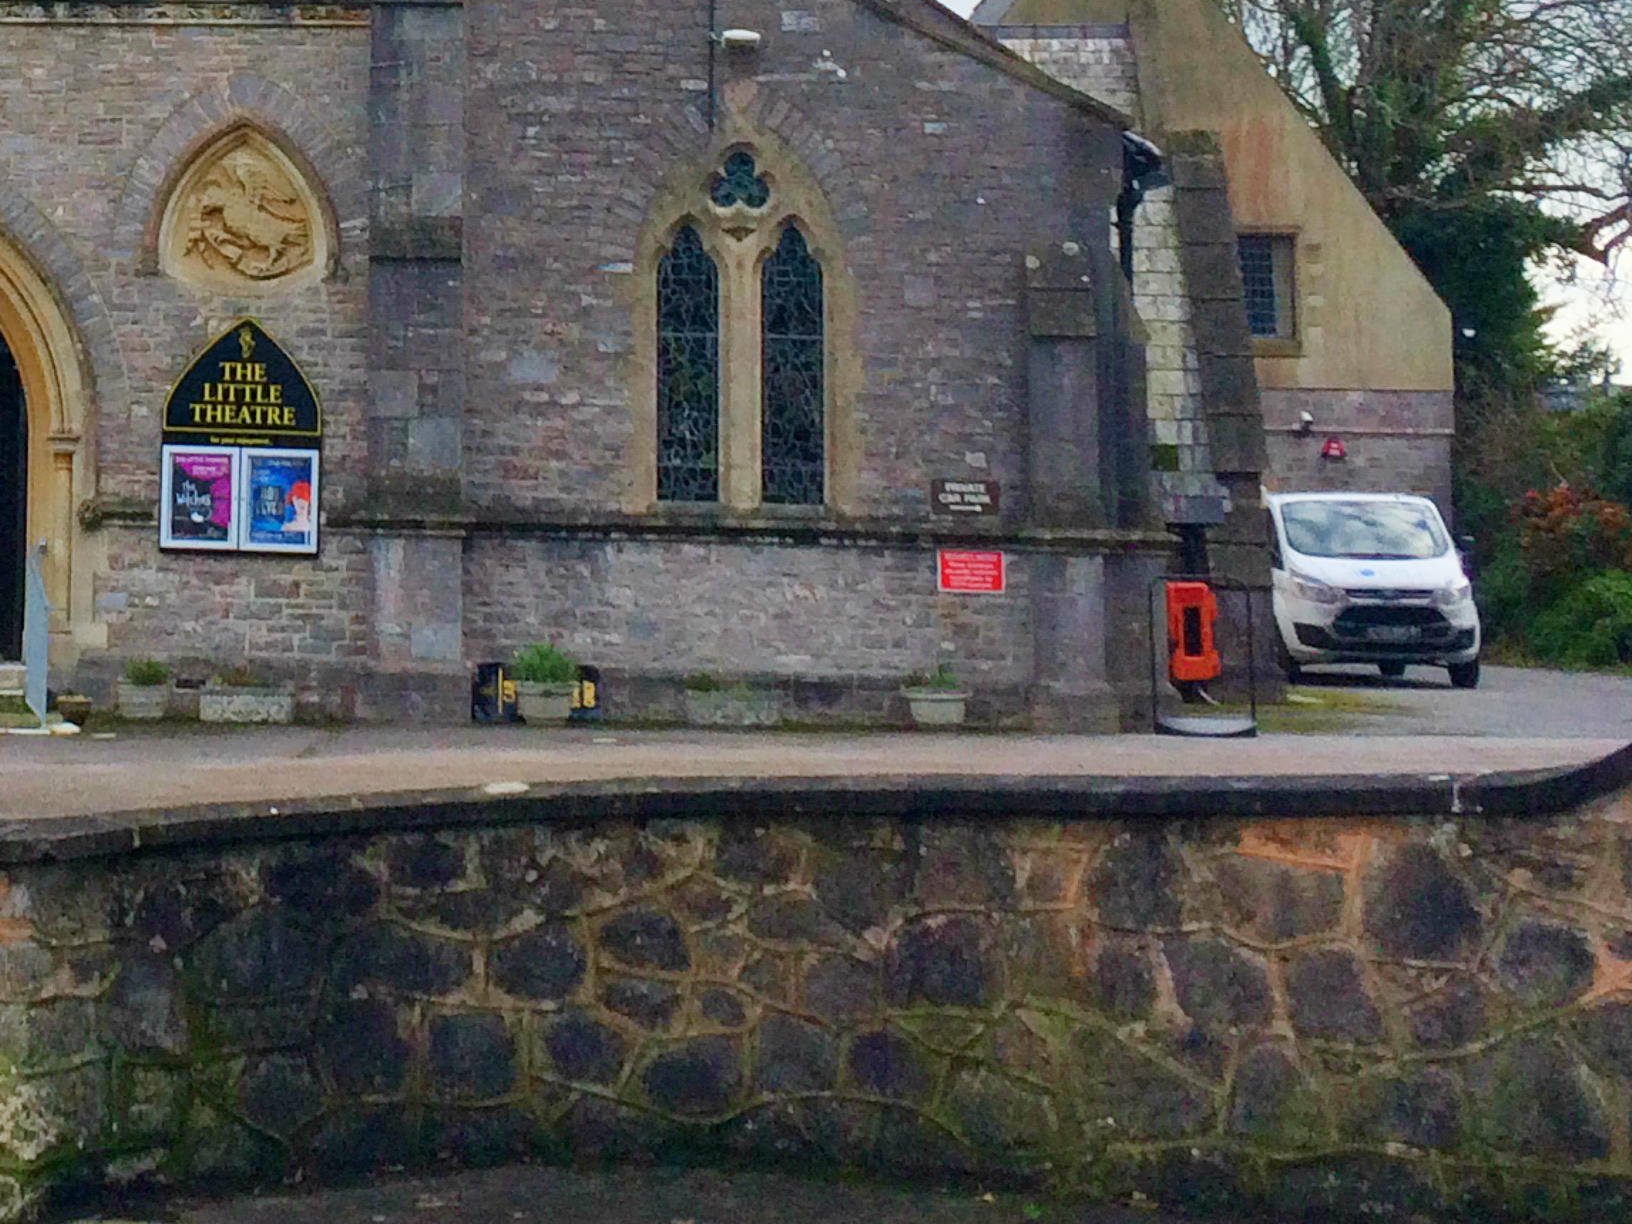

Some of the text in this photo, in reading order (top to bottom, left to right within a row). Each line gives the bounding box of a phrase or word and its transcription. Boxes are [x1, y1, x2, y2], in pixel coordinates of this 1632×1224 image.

[219, 362, 267, 381] THE
[202, 382, 283, 403] LITTLE
[189, 404, 296, 426] THEATRE
